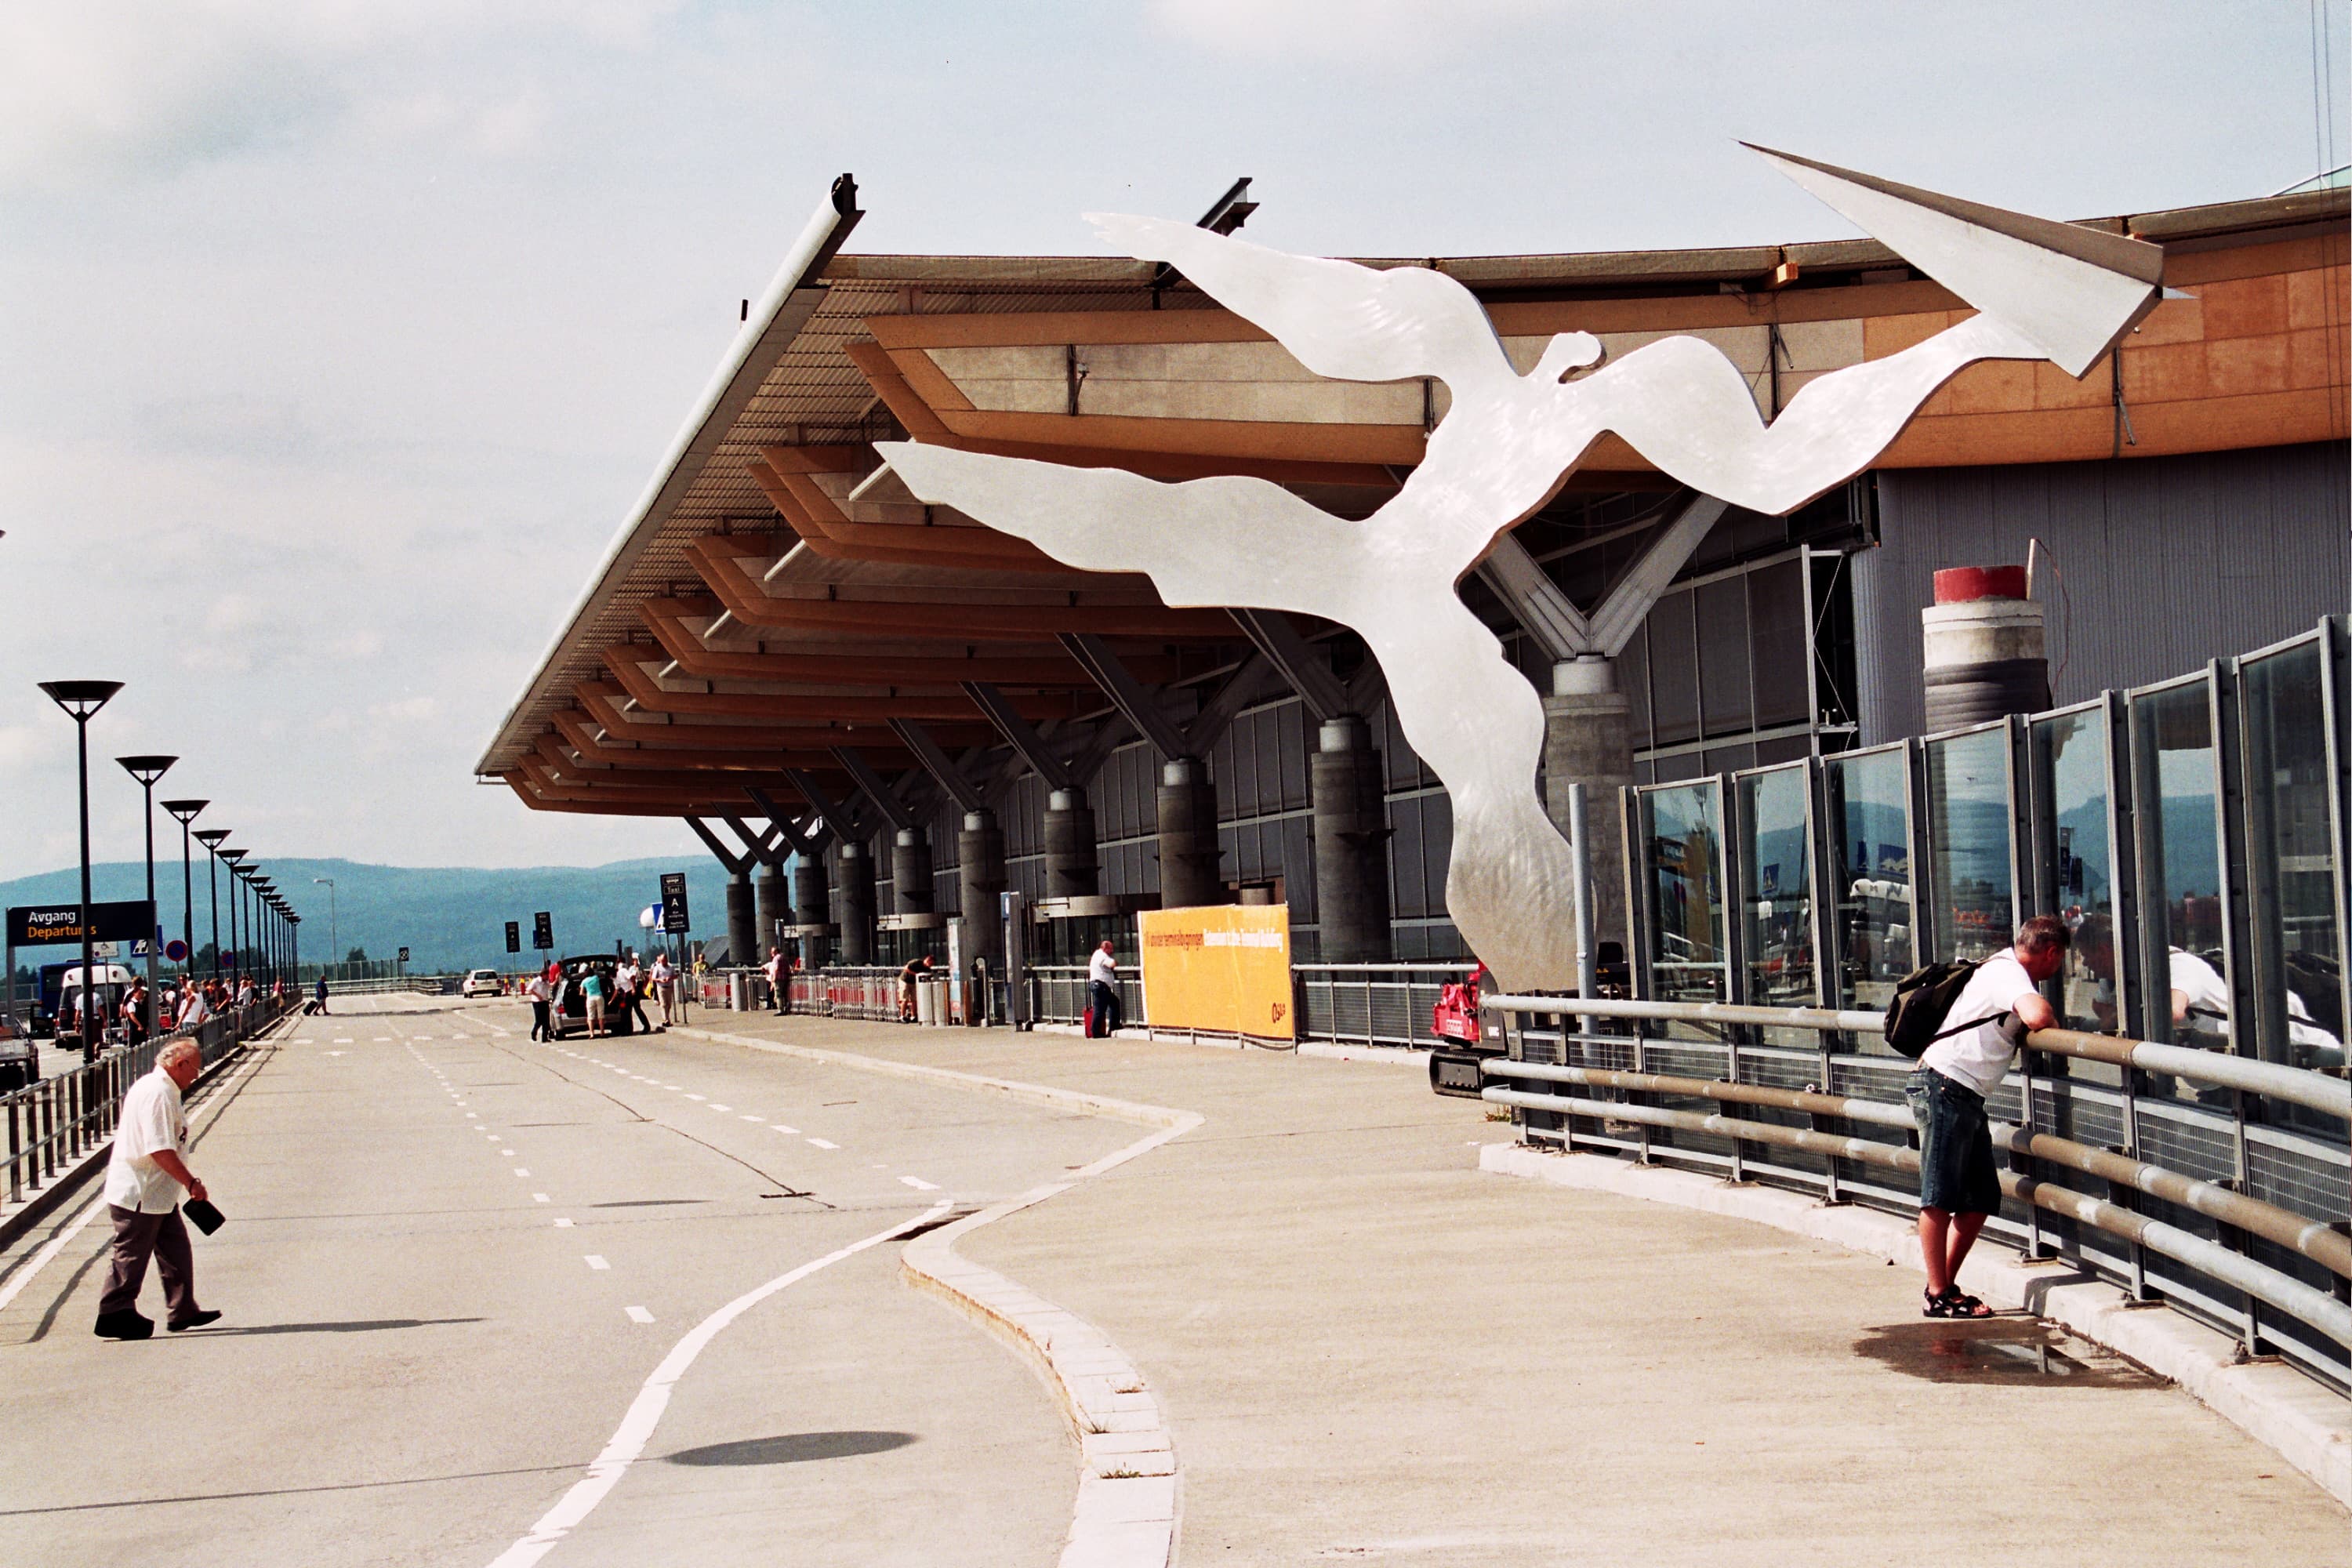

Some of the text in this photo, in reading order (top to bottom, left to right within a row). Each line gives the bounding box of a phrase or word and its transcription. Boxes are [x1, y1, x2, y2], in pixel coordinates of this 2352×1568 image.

[671, 897, 679, 907] A
[28, 911, 76, 925] Avgang
[27, 925, 97, 941] Departurs
